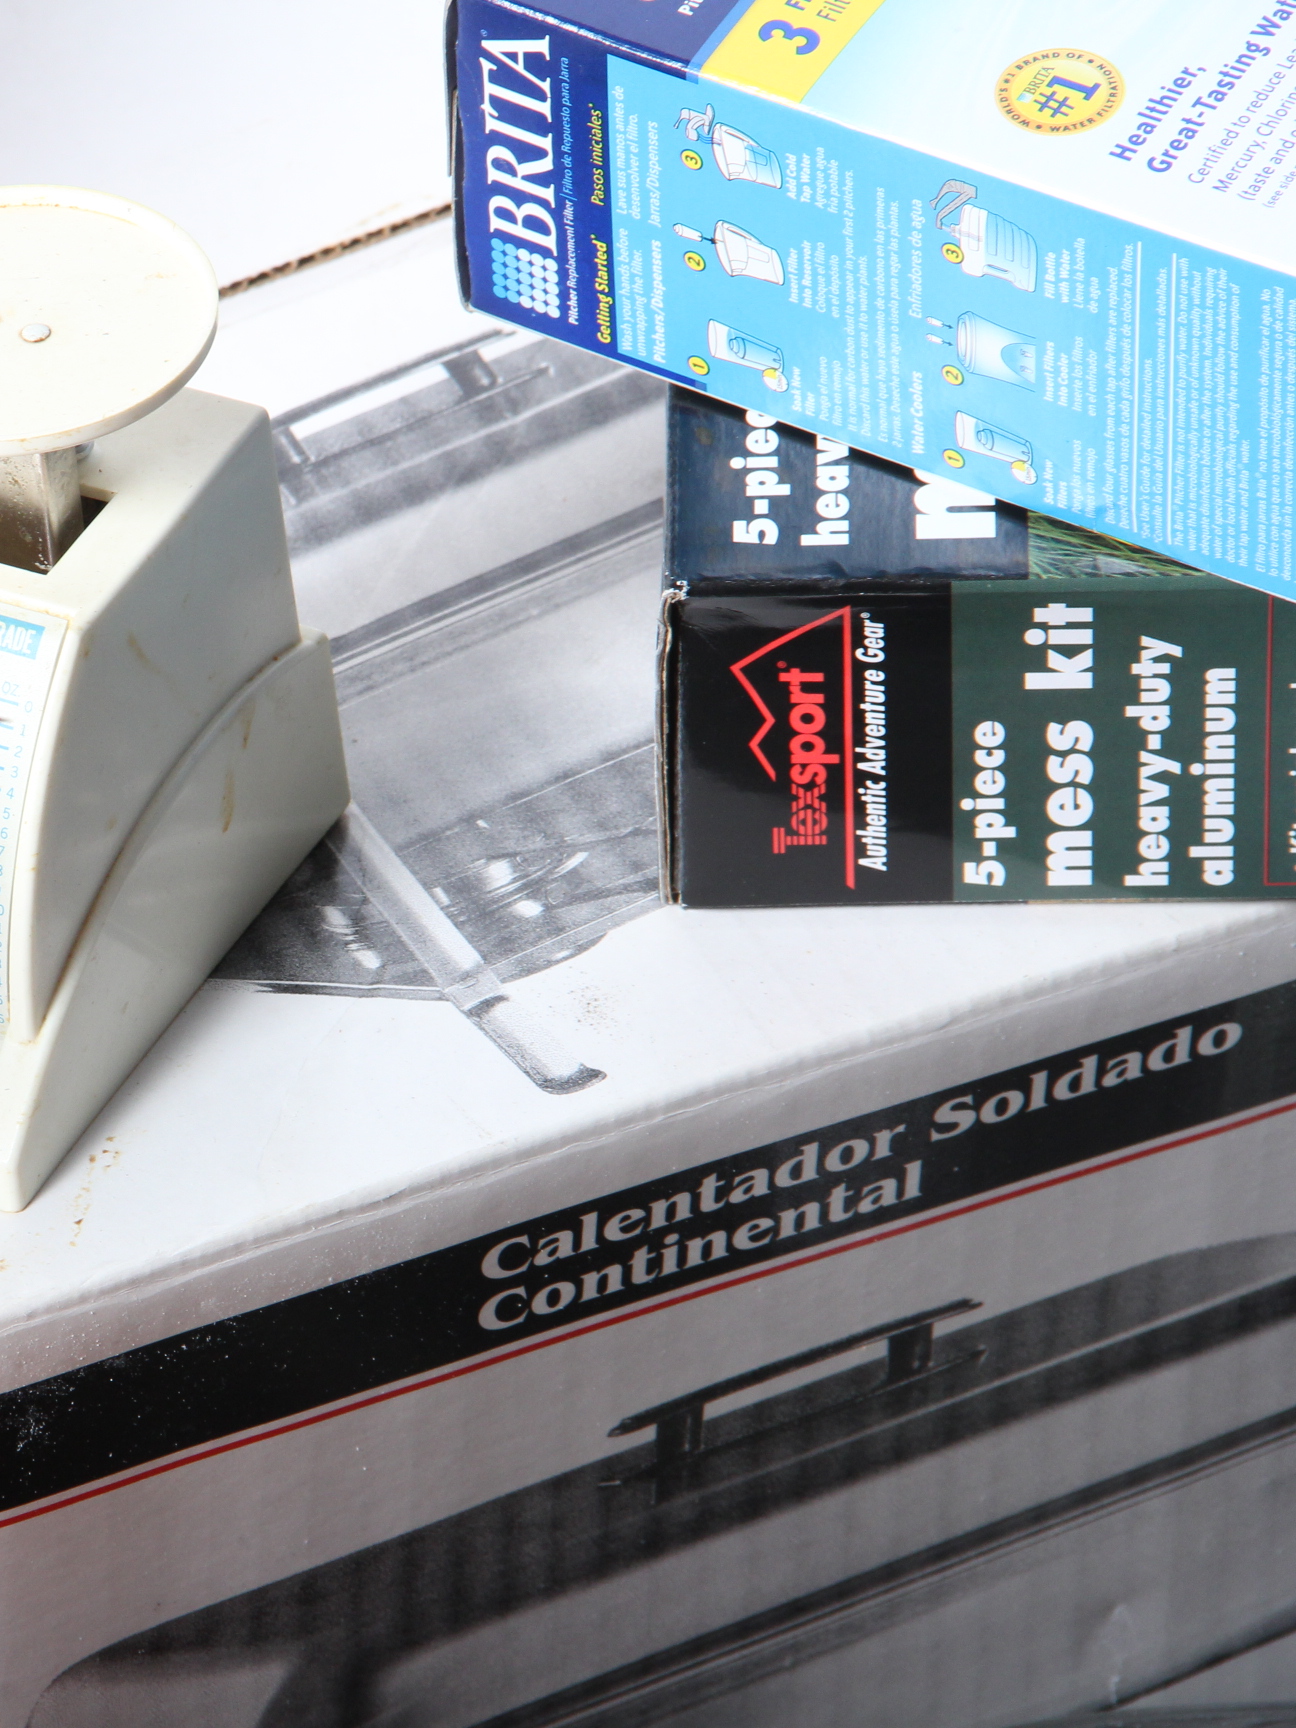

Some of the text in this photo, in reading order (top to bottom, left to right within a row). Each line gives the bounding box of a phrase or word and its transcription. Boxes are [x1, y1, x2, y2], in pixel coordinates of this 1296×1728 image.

[758, 19, 820, 55] 3
[1015, 52, 1060, 70] BRAND
[1066, 52, 1084, 60] OF
[1024, 66, 1055, 95] BRITA
[1033, 75, 1101, 118] #1
[1049, 63, 1119, 132] WATER FILTRATION
[1147, 40, 1271, 173] Great-Tasting
[1108, 66, 1208, 161] Healthier,
[1187, 127, 1240, 184] Certified
[1231, 114, 1251, 128] to
[1245, 70, 1286, 114] reduce
[612, 84, 627, 214] Lave sus manos antes de
[625, 111, 641, 219] desenvolver el filtro.
[644, 119, 663, 227] Jarras/Dispensers
[786, 153, 796, 198] Add Cold
[799, 152, 812, 204] Tap Water
[1212, 139, 1268, 193] Mercury,
[1236, 138, 1296, 201] (taste and
[558, 56, 578, 324] Pitcher Replacement Filter Filtro de Repuesto para Jarra
[589, 166, 605, 205] Pasos
[1262, 189, 1283, 208] (see
[787, 247, 798, 302] Insert Filter
[801, 239, 812, 307] Into Reservoir
[907, 197, 924, 318] Enfriadores de agua
[1044, 251, 1055, 298] Fill Bottle
[1058, 248, 1069, 304] with Water
[595, 292, 615, 345] Getting
[616, 227, 633, 351] Wash your hands before
[630, 247, 648, 356] unwrapping the filter.
[648, 238, 667, 363] Pitchers/Dispensers
[790, 366, 801, 411] Soak New
[1043, 340, 1054, 401] Insert Filters
[1058, 352, 1068, 406] Into Cooler
[804, 391, 815, 416] Filter
[909, 369, 924, 455] Water Coolers
[20, 724, 26, 736] 1
[25, 701, 33, 713] 0
[855, 669, 887, 776] Adventure
[11, 766, 18, 778] 3
[14, 746, 22, 758] 2
[1024, 603, 1094, 887] mess kit
[1123, 635, 1183, 886] heavy-duty
[6, 787, 14, 799] 4
[962, 721, 1016, 887] 5-piece
[1188, 667, 1237, 886] aluminum
[0, 827, 8, 839] 6
[3, 807, 11, 820] 5
[856, 780, 887, 871] Authentic
[482, 1019, 1243, 1281] Calentador Soldado
[477, 1163, 923, 1331] Continental
